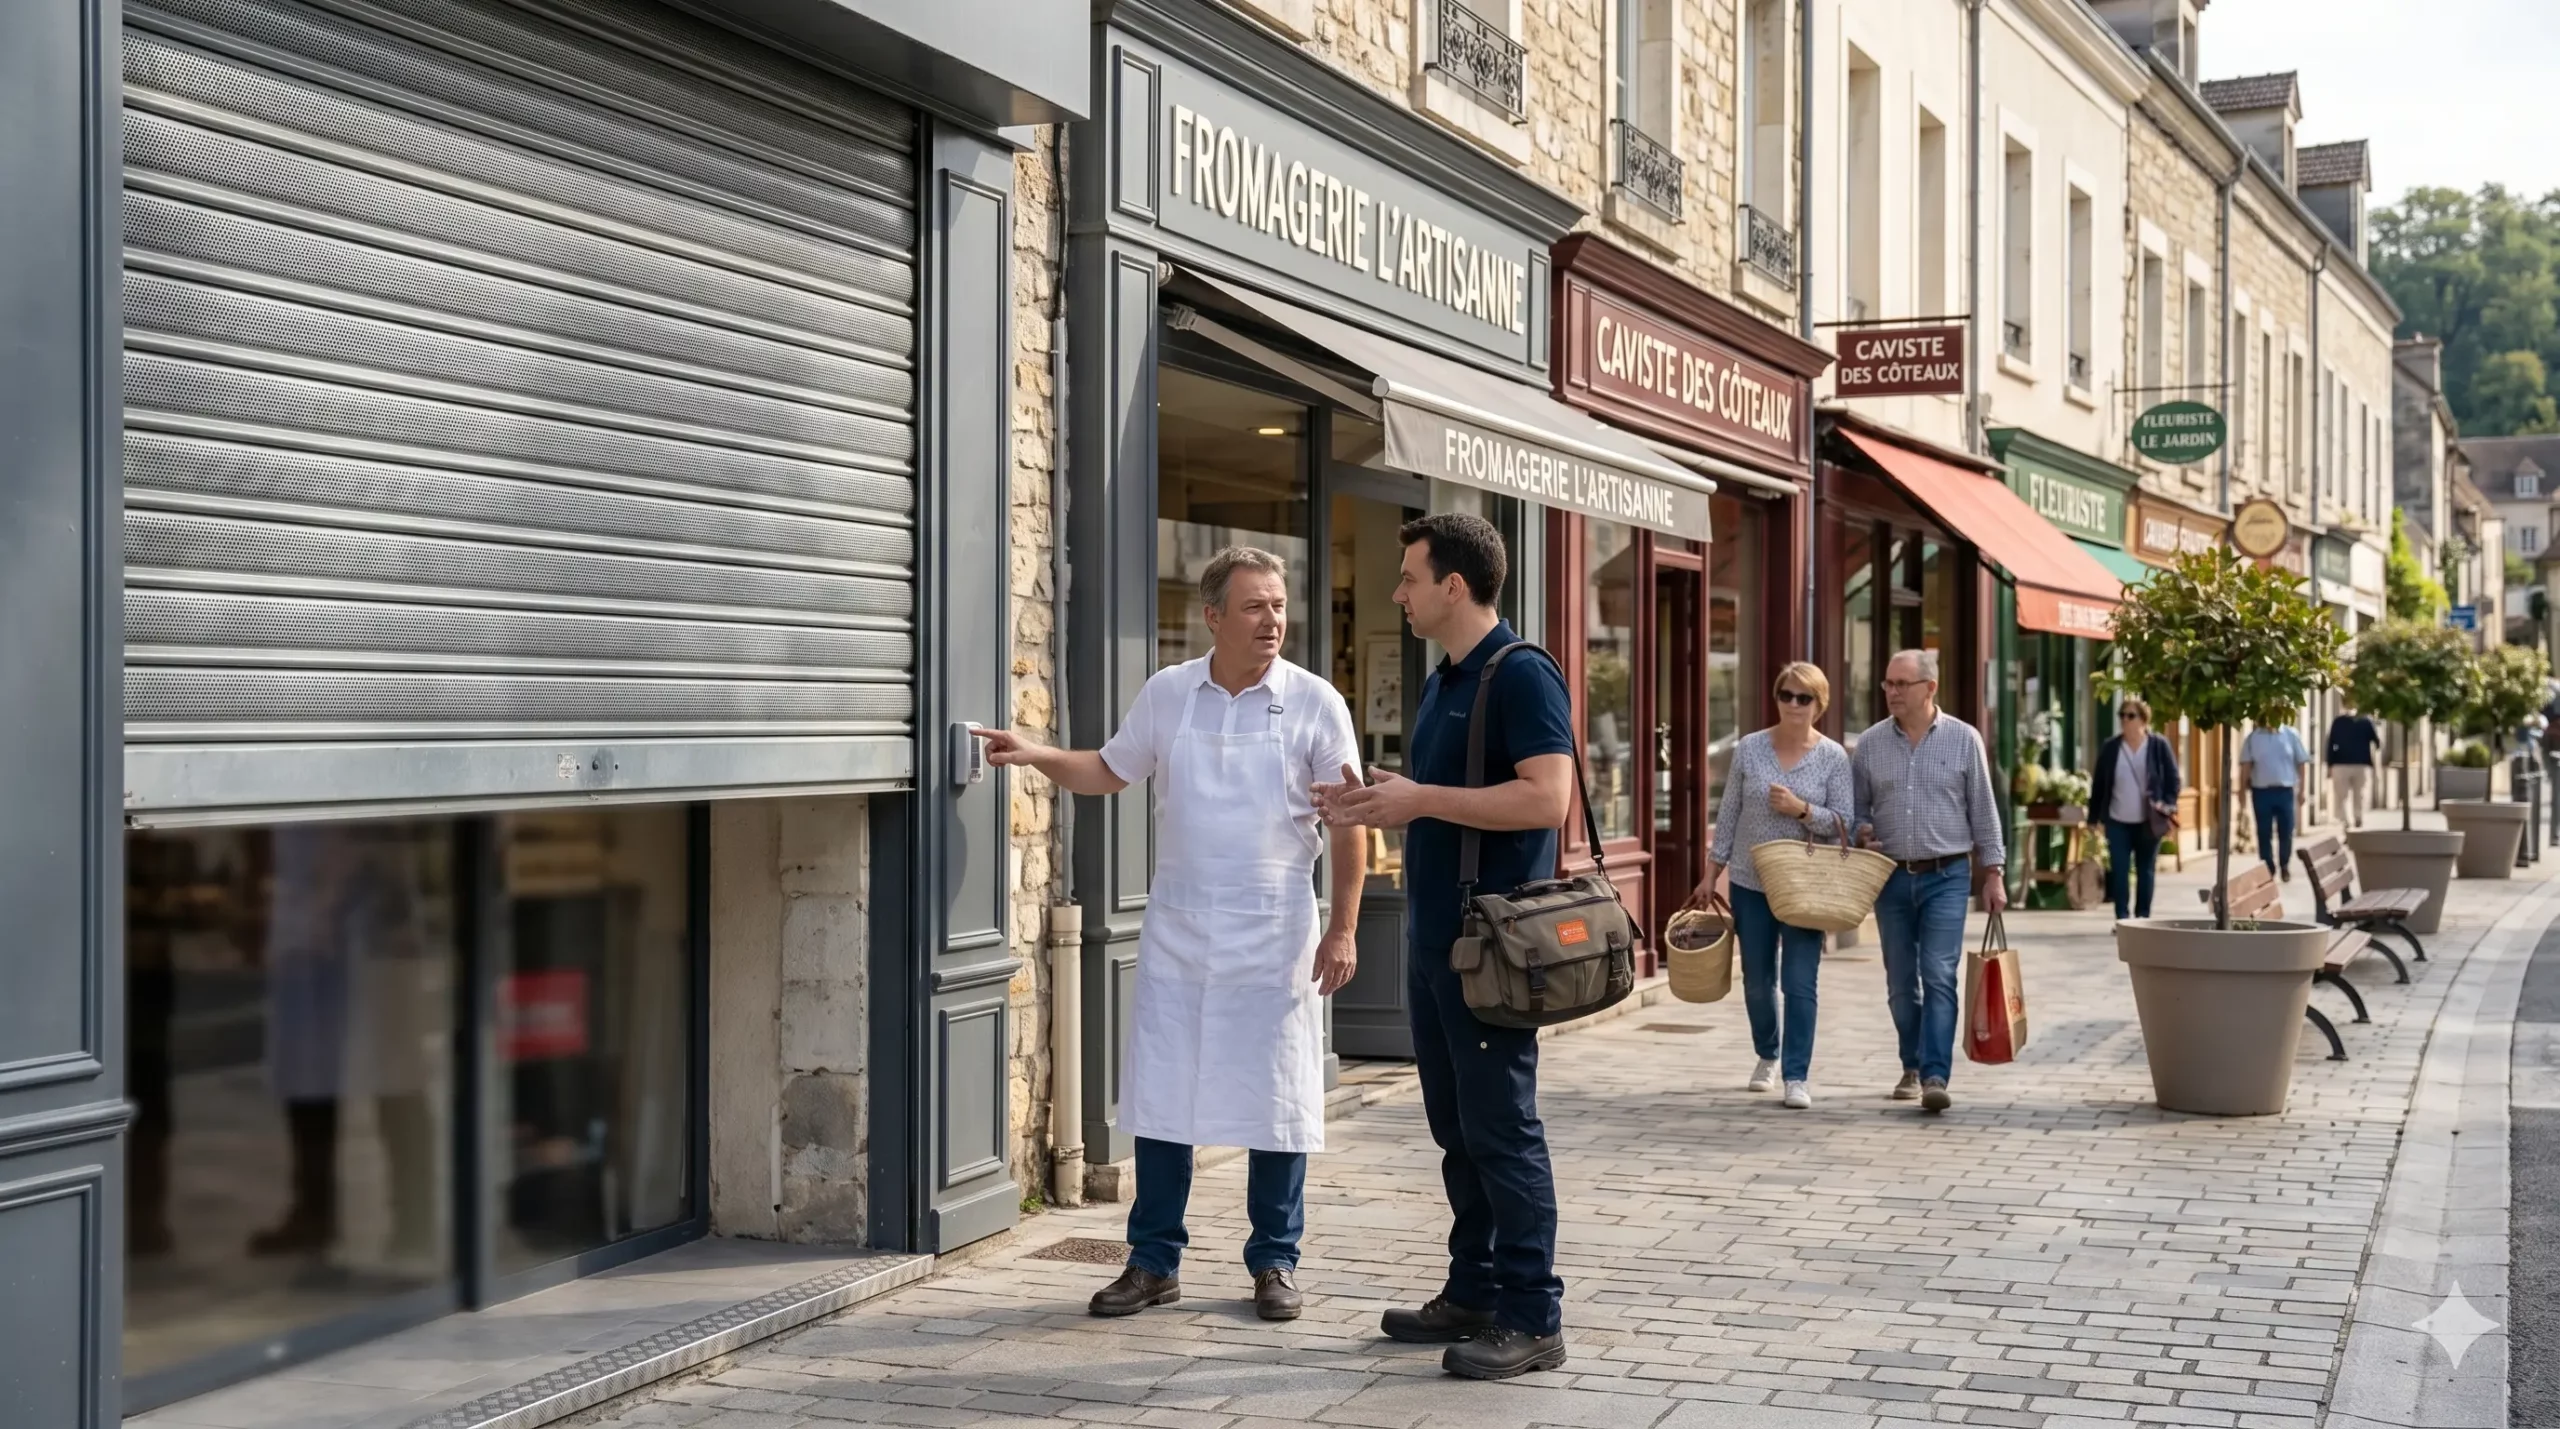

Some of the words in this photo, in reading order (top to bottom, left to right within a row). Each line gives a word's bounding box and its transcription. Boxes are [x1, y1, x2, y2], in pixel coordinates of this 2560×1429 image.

[1171, 104, 1370, 272] FROMAGERIE
[1375, 200, 1525, 335] L'ARTISANNE
[1855, 336, 1945, 360] CAVISTE
[1596, 316, 1678, 399] CAVISTE
[1682, 351, 1715, 414] DES
[1718, 361, 1793, 442] CÔTEAUX
[1841, 366, 1872, 385] DES
[1877, 361, 1959, 383] CÔTEAUX
[2140, 434, 2159, 449] LE
[2162, 432, 2217, 448] JARDIN
[2142, 412, 2216, 428] FLEURISTE
[1445, 428, 1570, 501] FROMAGERIE
[1574, 464, 1674, 527] L'ARTISANNE
[2029, 472, 2106, 533] FLEURISTE
